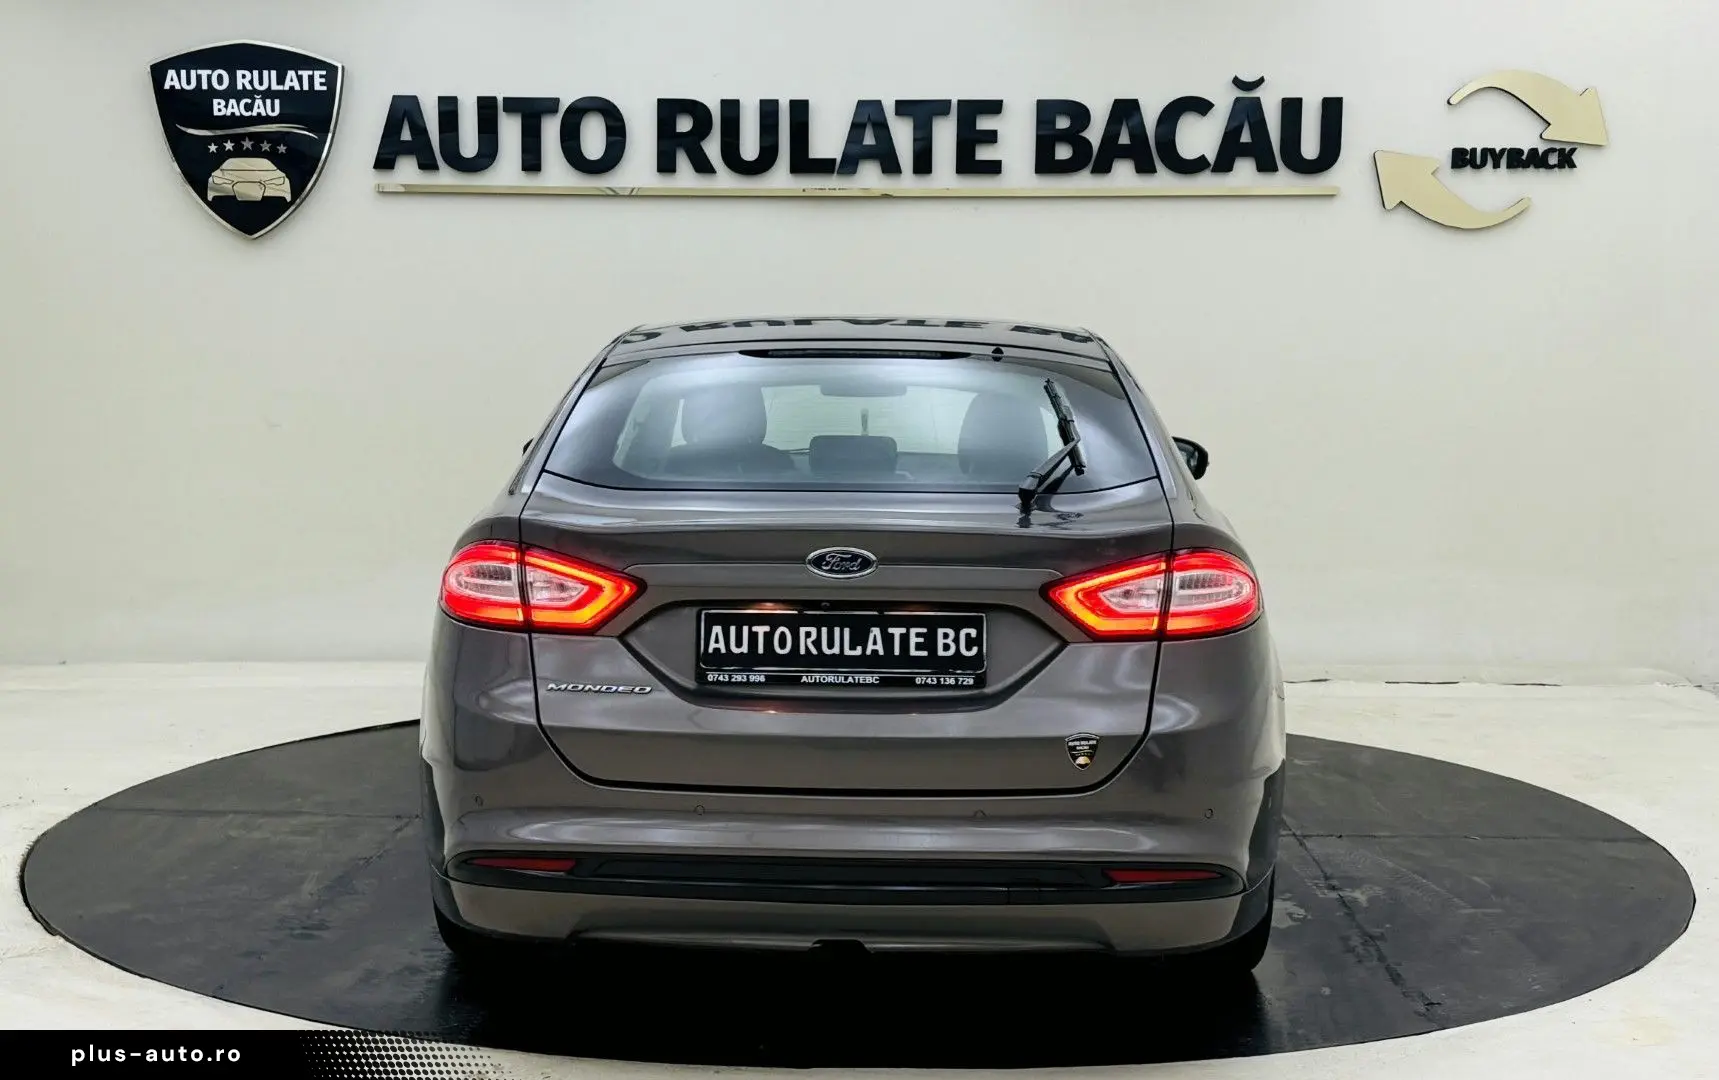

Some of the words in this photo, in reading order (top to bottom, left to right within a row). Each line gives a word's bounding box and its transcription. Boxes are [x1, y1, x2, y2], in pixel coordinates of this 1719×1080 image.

[163, 69, 230, 91] AUTO
[236, 69, 328, 91] RULATE
[212, 94, 281, 117] BACĂU
[373, 94, 627, 175] AUTO
[656, 97, 1004, 176] RULATE
[1034, 75, 1344, 176] BACĂU
[1450, 147, 1578, 170] BUYBACK
[821, 552, 863, 571] Ford
[707, 624, 793, 655] AUTO
[799, 626, 929, 657] RULATE
[936, 627, 979, 657] BC
[707, 673, 729, 682] 0743
[800, 675, 880, 684] AUTORULATEBC
[915, 677, 938, 685] 0743
[546, 682, 653, 694] MONDEO
